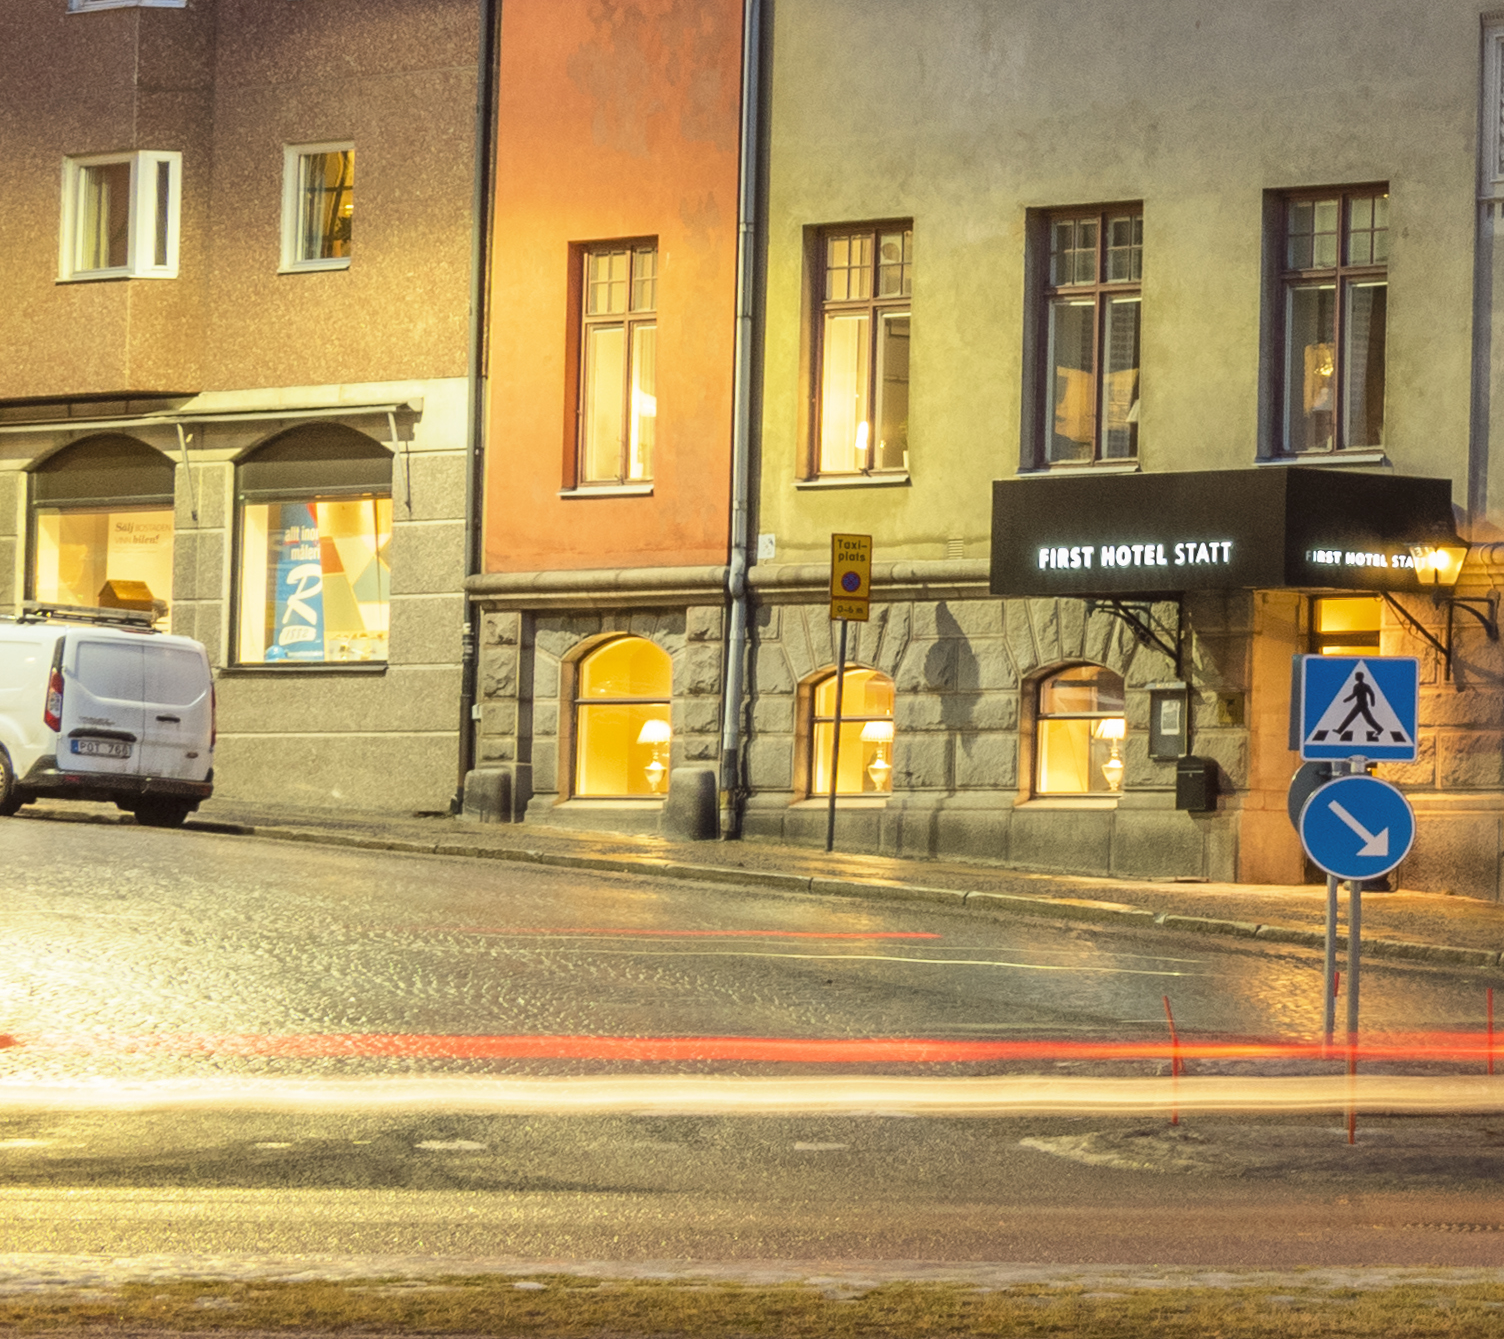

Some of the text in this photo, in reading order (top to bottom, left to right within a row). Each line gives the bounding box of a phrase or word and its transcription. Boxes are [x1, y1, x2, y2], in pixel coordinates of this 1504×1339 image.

[284, 525, 300, 541] allt
[837, 538, 868, 550] Taxi-
[838, 551, 866, 563] plats
[1038, 540, 1233, 570] FIRST HOTEL STATT
[1305, 550, 1342, 565] FIRST
[1345, 552, 1388, 568] HOTEL
[80, 742, 101, 754] POT
